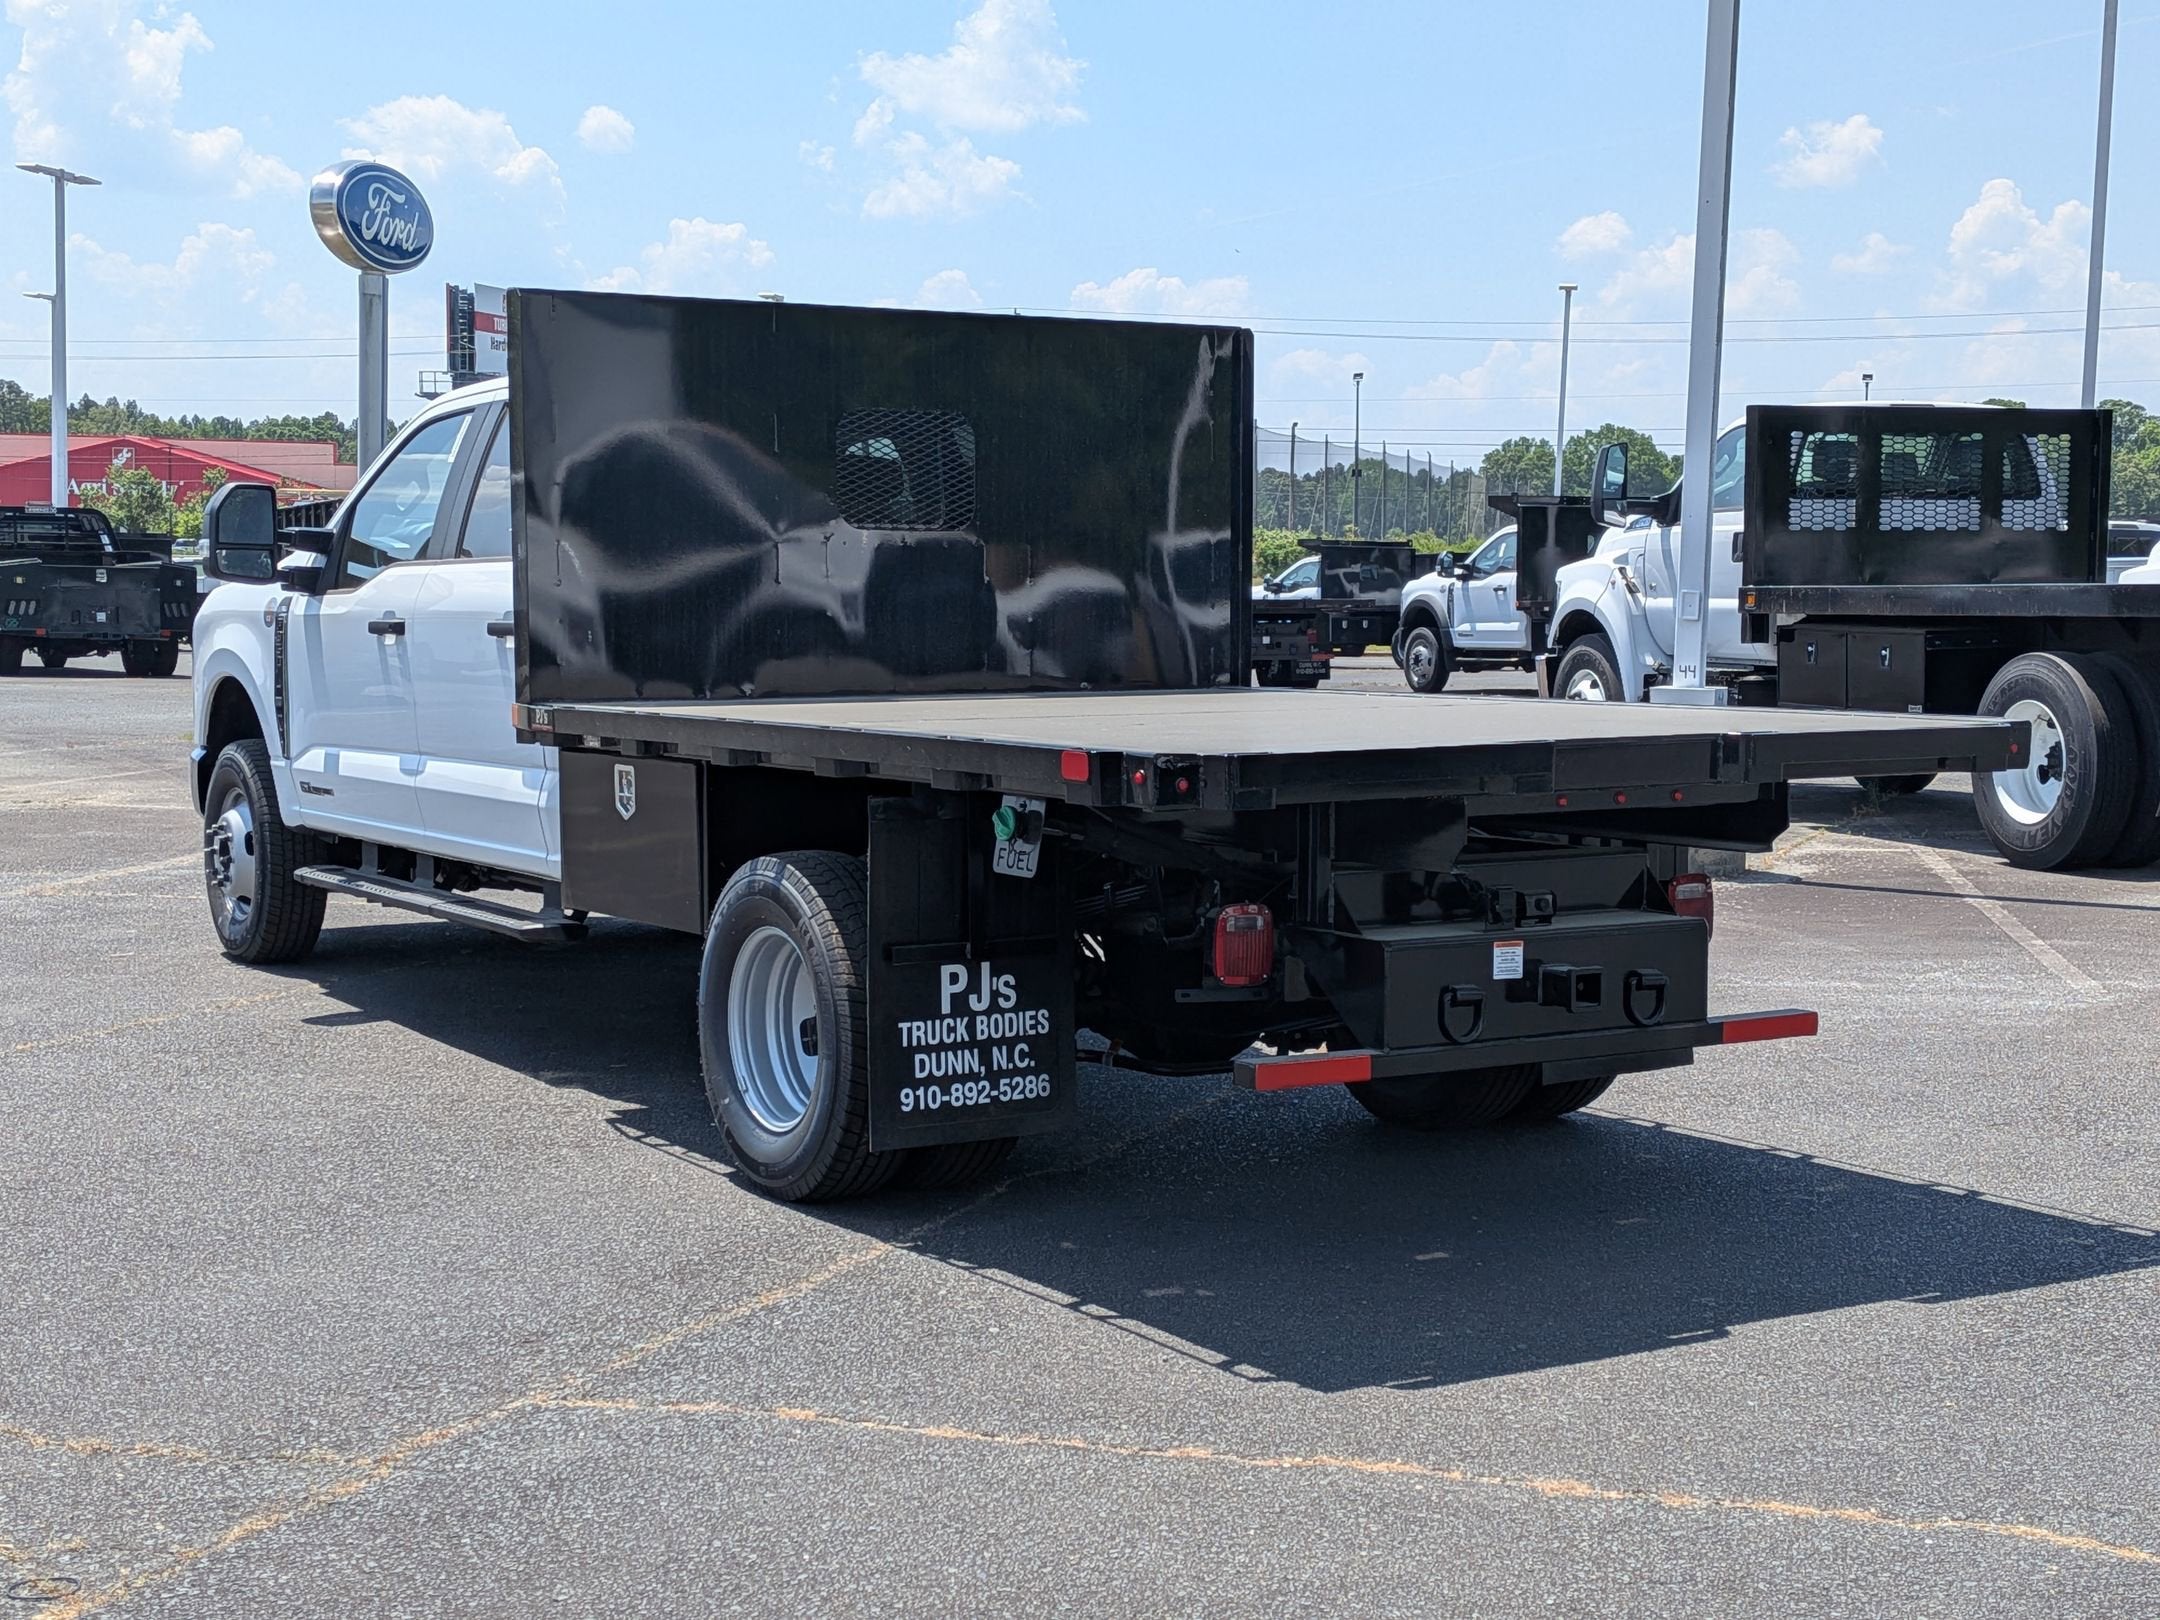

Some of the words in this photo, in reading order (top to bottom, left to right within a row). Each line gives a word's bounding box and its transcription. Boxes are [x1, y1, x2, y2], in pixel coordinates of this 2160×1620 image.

[361, 182, 420, 252] Ford
[1679, 664, 1697, 679] 44
[996, 847, 1034, 873] FUEL
[939, 961, 1017, 1015] PJ's
[898, 1016, 970, 1048] TRUCK
[976, 1009, 1050, 1042] BODIES
[914, 1049, 986, 1079] DUNN,
[992, 1043, 1036, 1071] N.C.
[900, 1073, 1051, 1113] 910-892-5286
